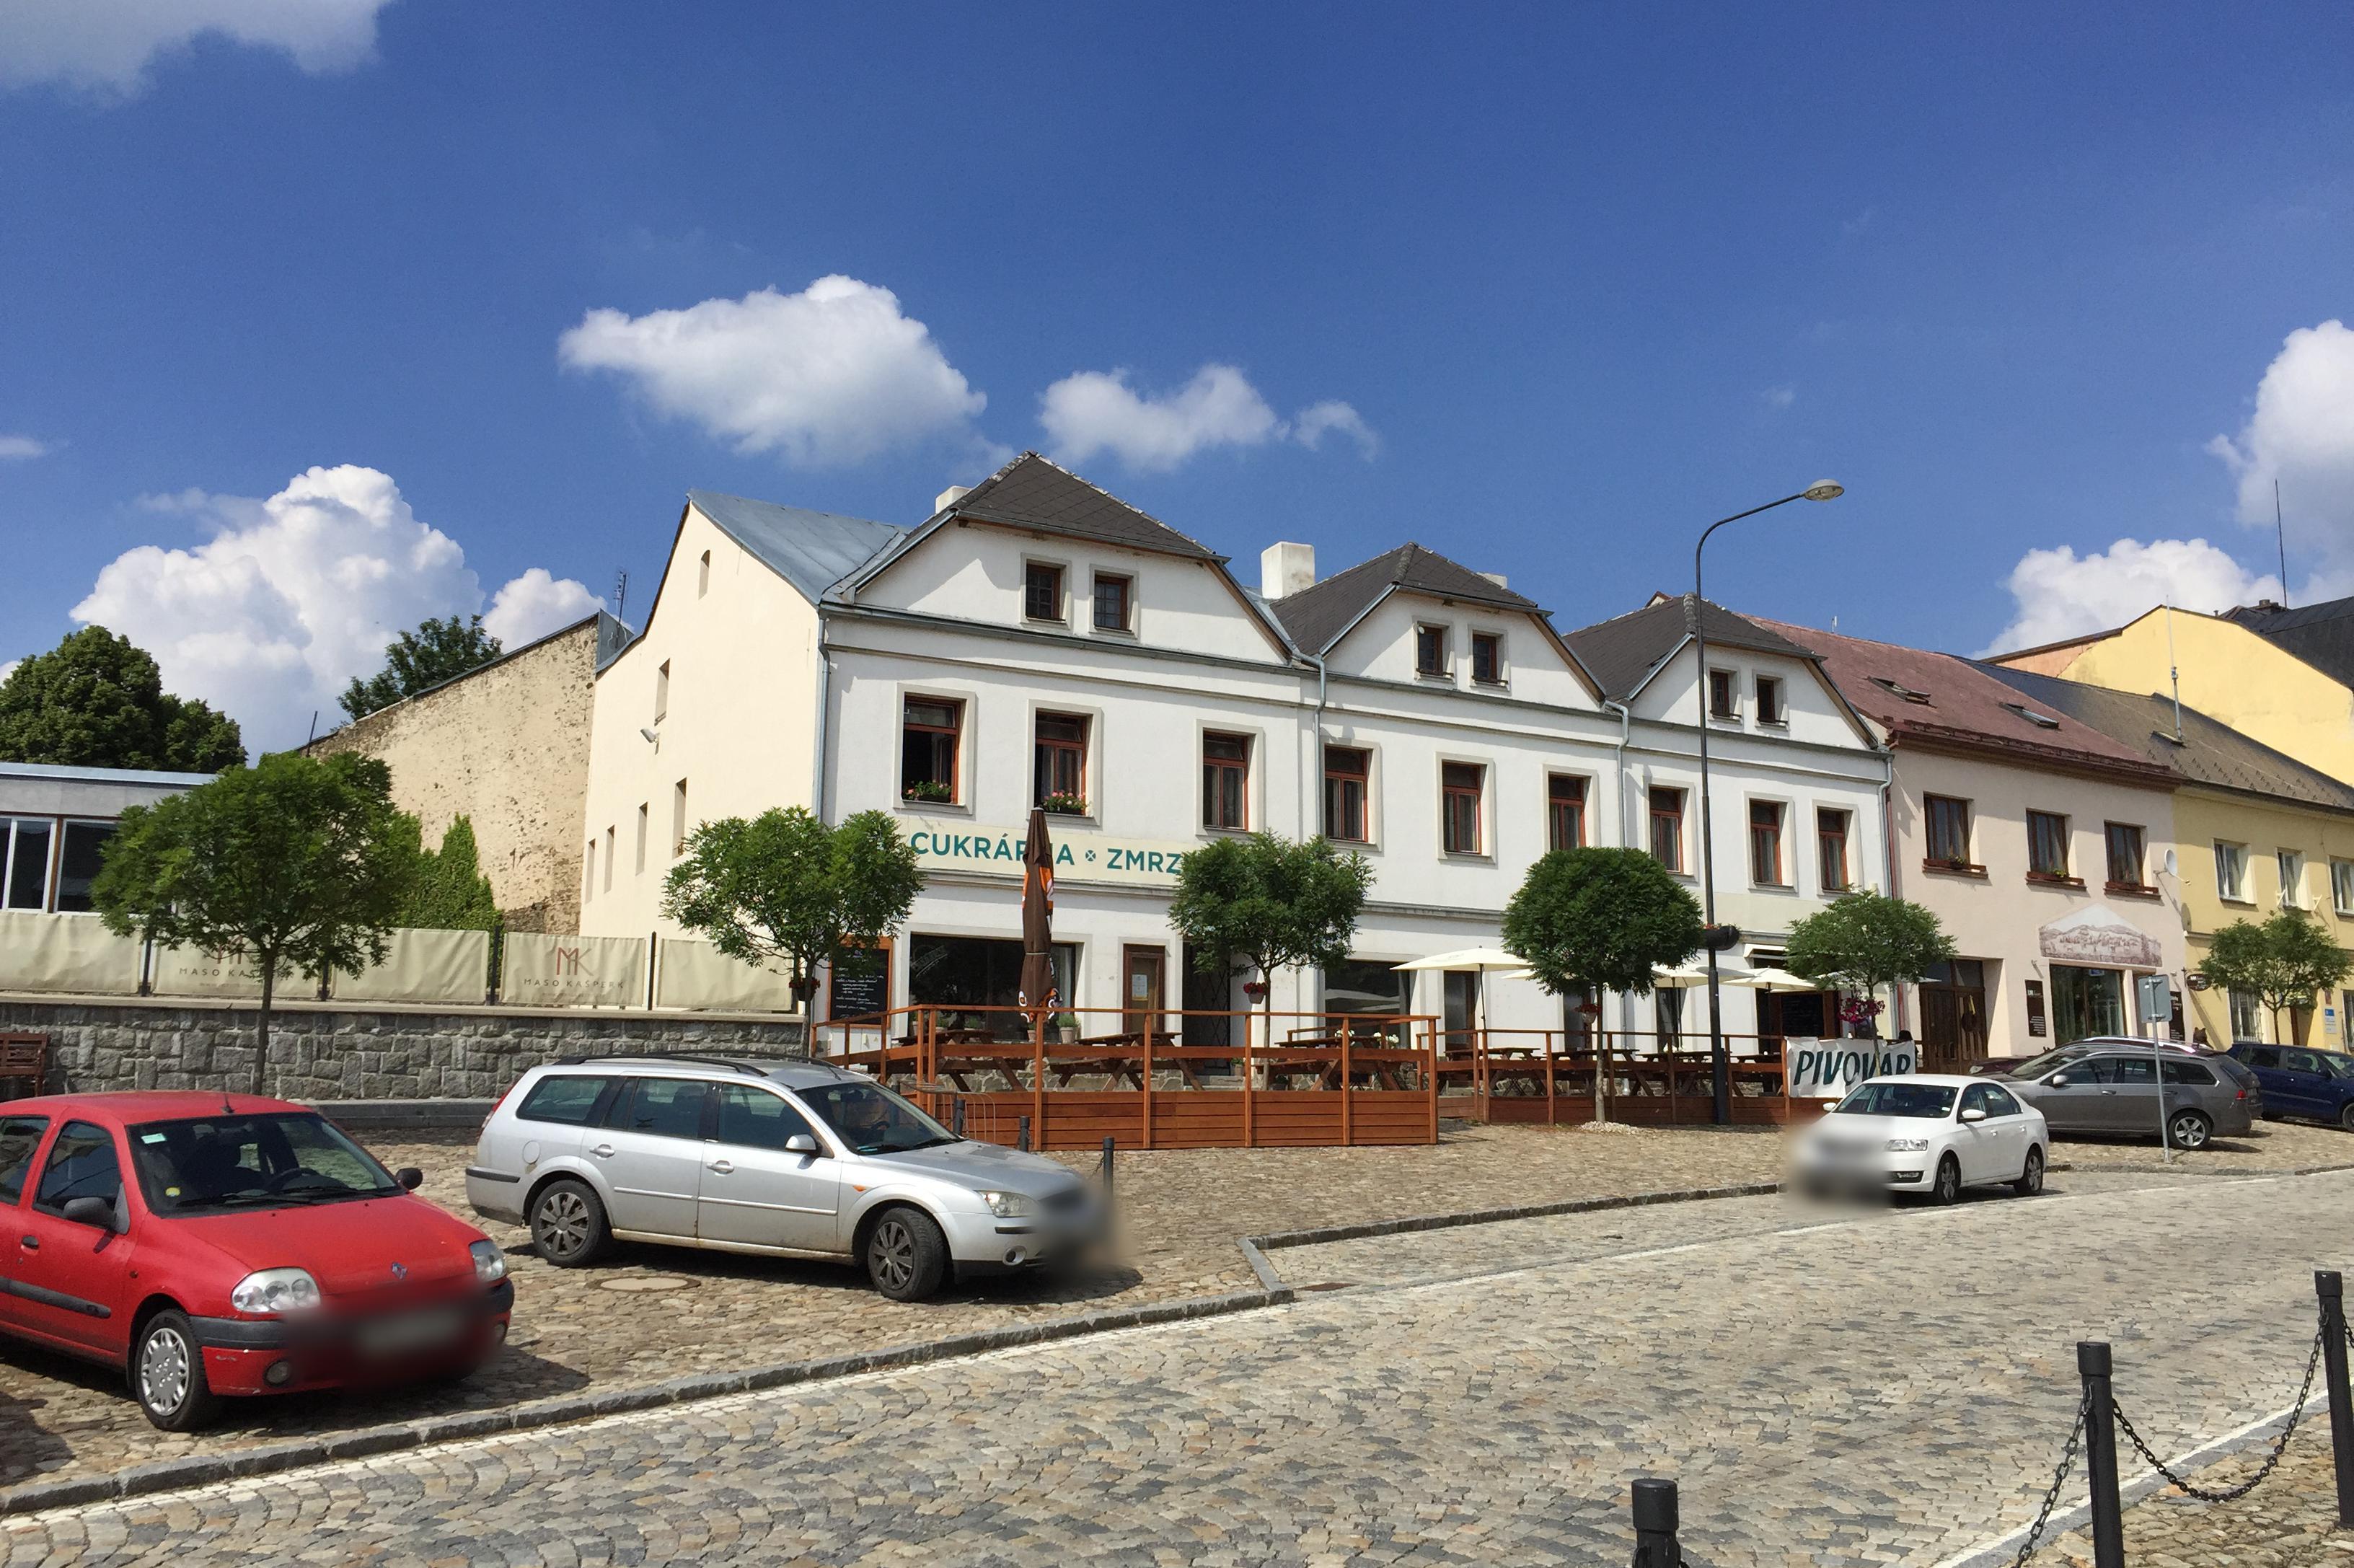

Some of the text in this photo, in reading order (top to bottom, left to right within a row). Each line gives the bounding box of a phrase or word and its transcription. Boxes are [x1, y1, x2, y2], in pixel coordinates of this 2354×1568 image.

[910, 832, 1183, 874] CUKRÁRA ZMRZ
[179, 967, 220, 977] MASO
[524, 978, 560, 987] MASO
[1794, 1049, 1911, 1086] PIVOVAR
